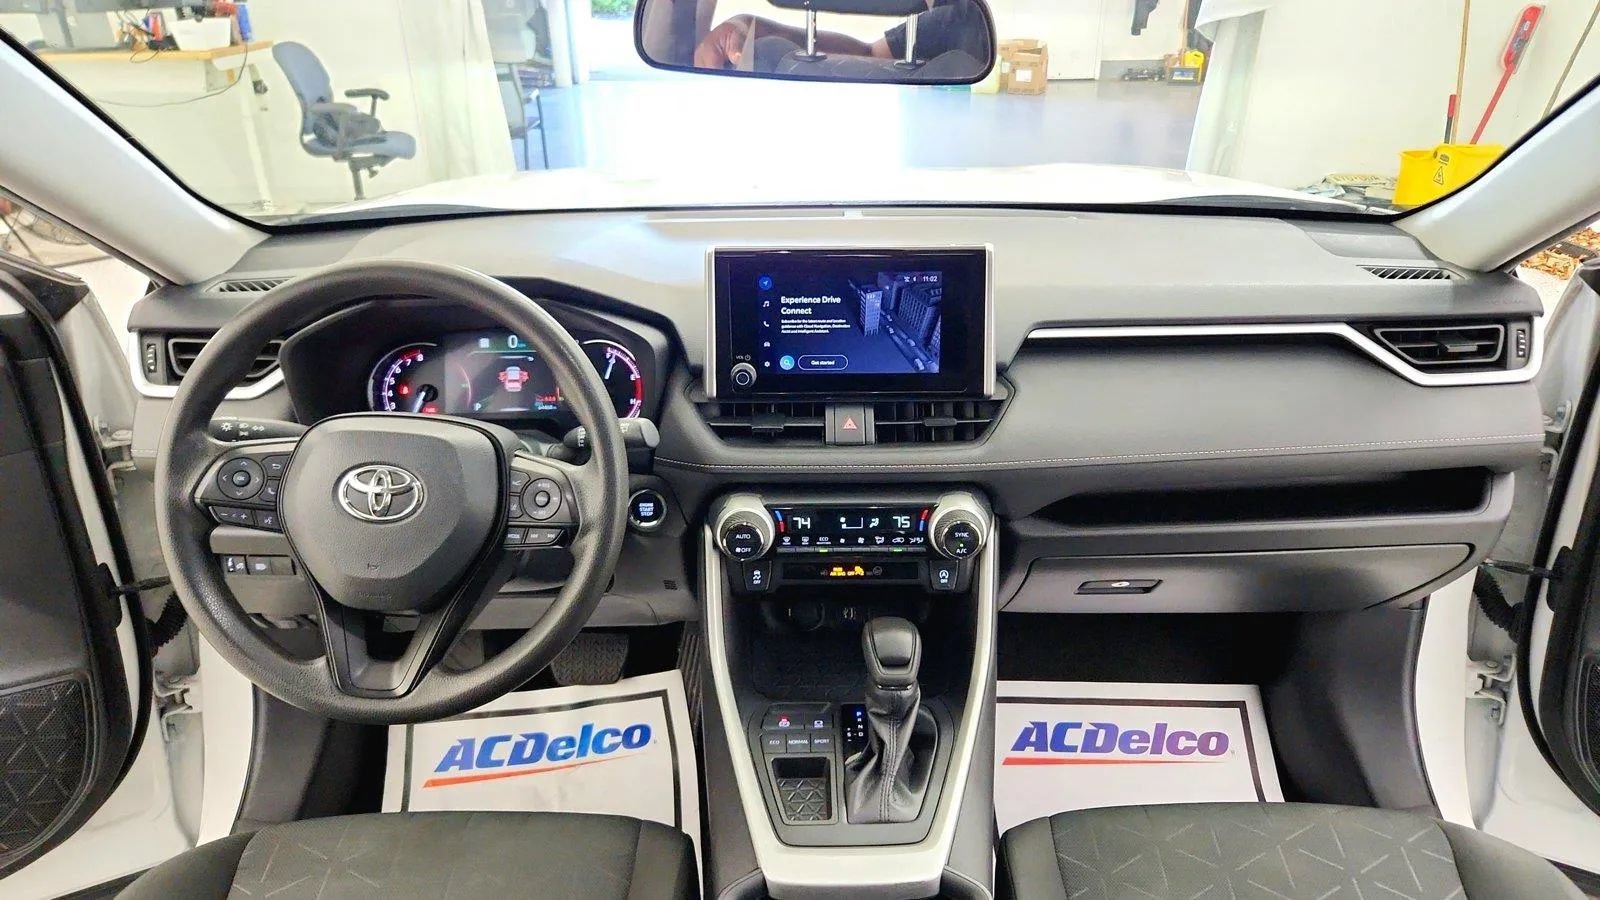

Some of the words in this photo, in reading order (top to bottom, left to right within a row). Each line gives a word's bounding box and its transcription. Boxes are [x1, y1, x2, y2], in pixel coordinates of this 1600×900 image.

[781, 296, 820, 305] Experience
[508, 335, 518, 348] 0
[390, 402, 396, 410] 3
[474, 402, 482, 411] P
[793, 517, 811, 529] 74
[892, 516, 910, 528] 75
[1010, 720, 1230, 756] ACDelco
[434, 723, 652, 772] ACDelco
